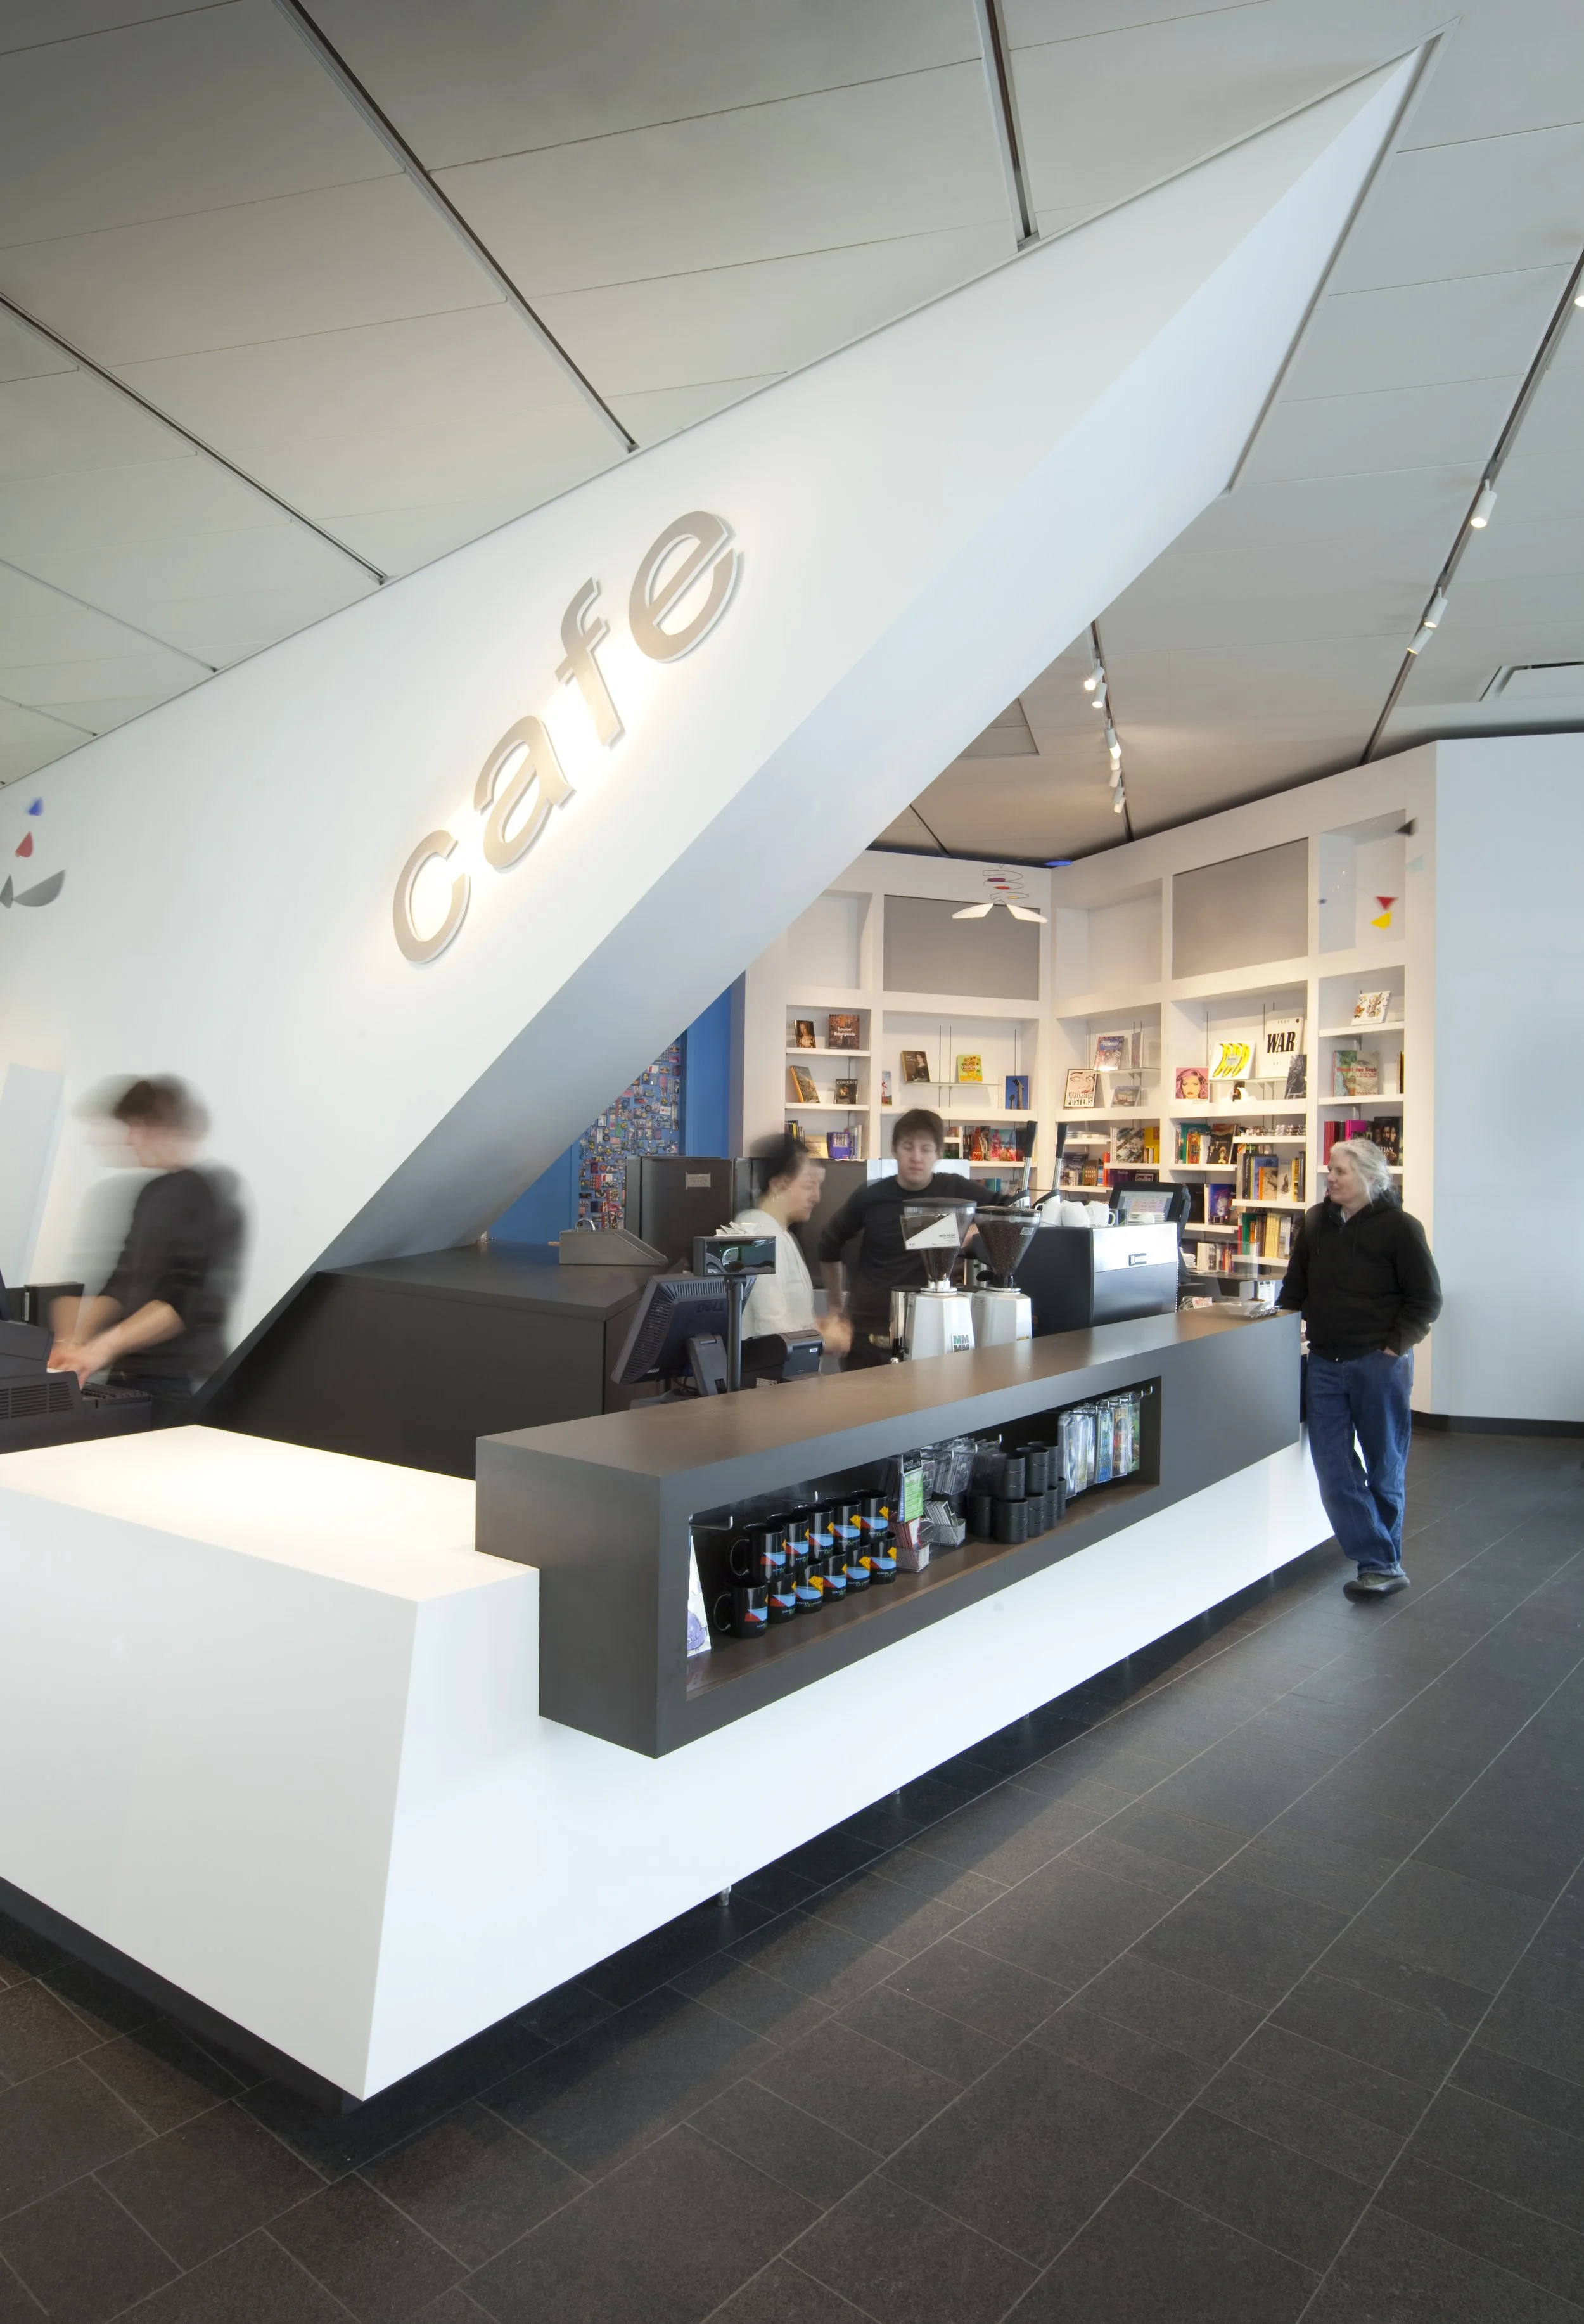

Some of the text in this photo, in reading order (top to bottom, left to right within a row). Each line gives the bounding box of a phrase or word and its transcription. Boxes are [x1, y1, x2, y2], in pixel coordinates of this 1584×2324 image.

[393, 511, 740, 966] cafe
[1267, 1031, 1296, 1053] WAR
[697, 1300, 724, 1313] DELL
